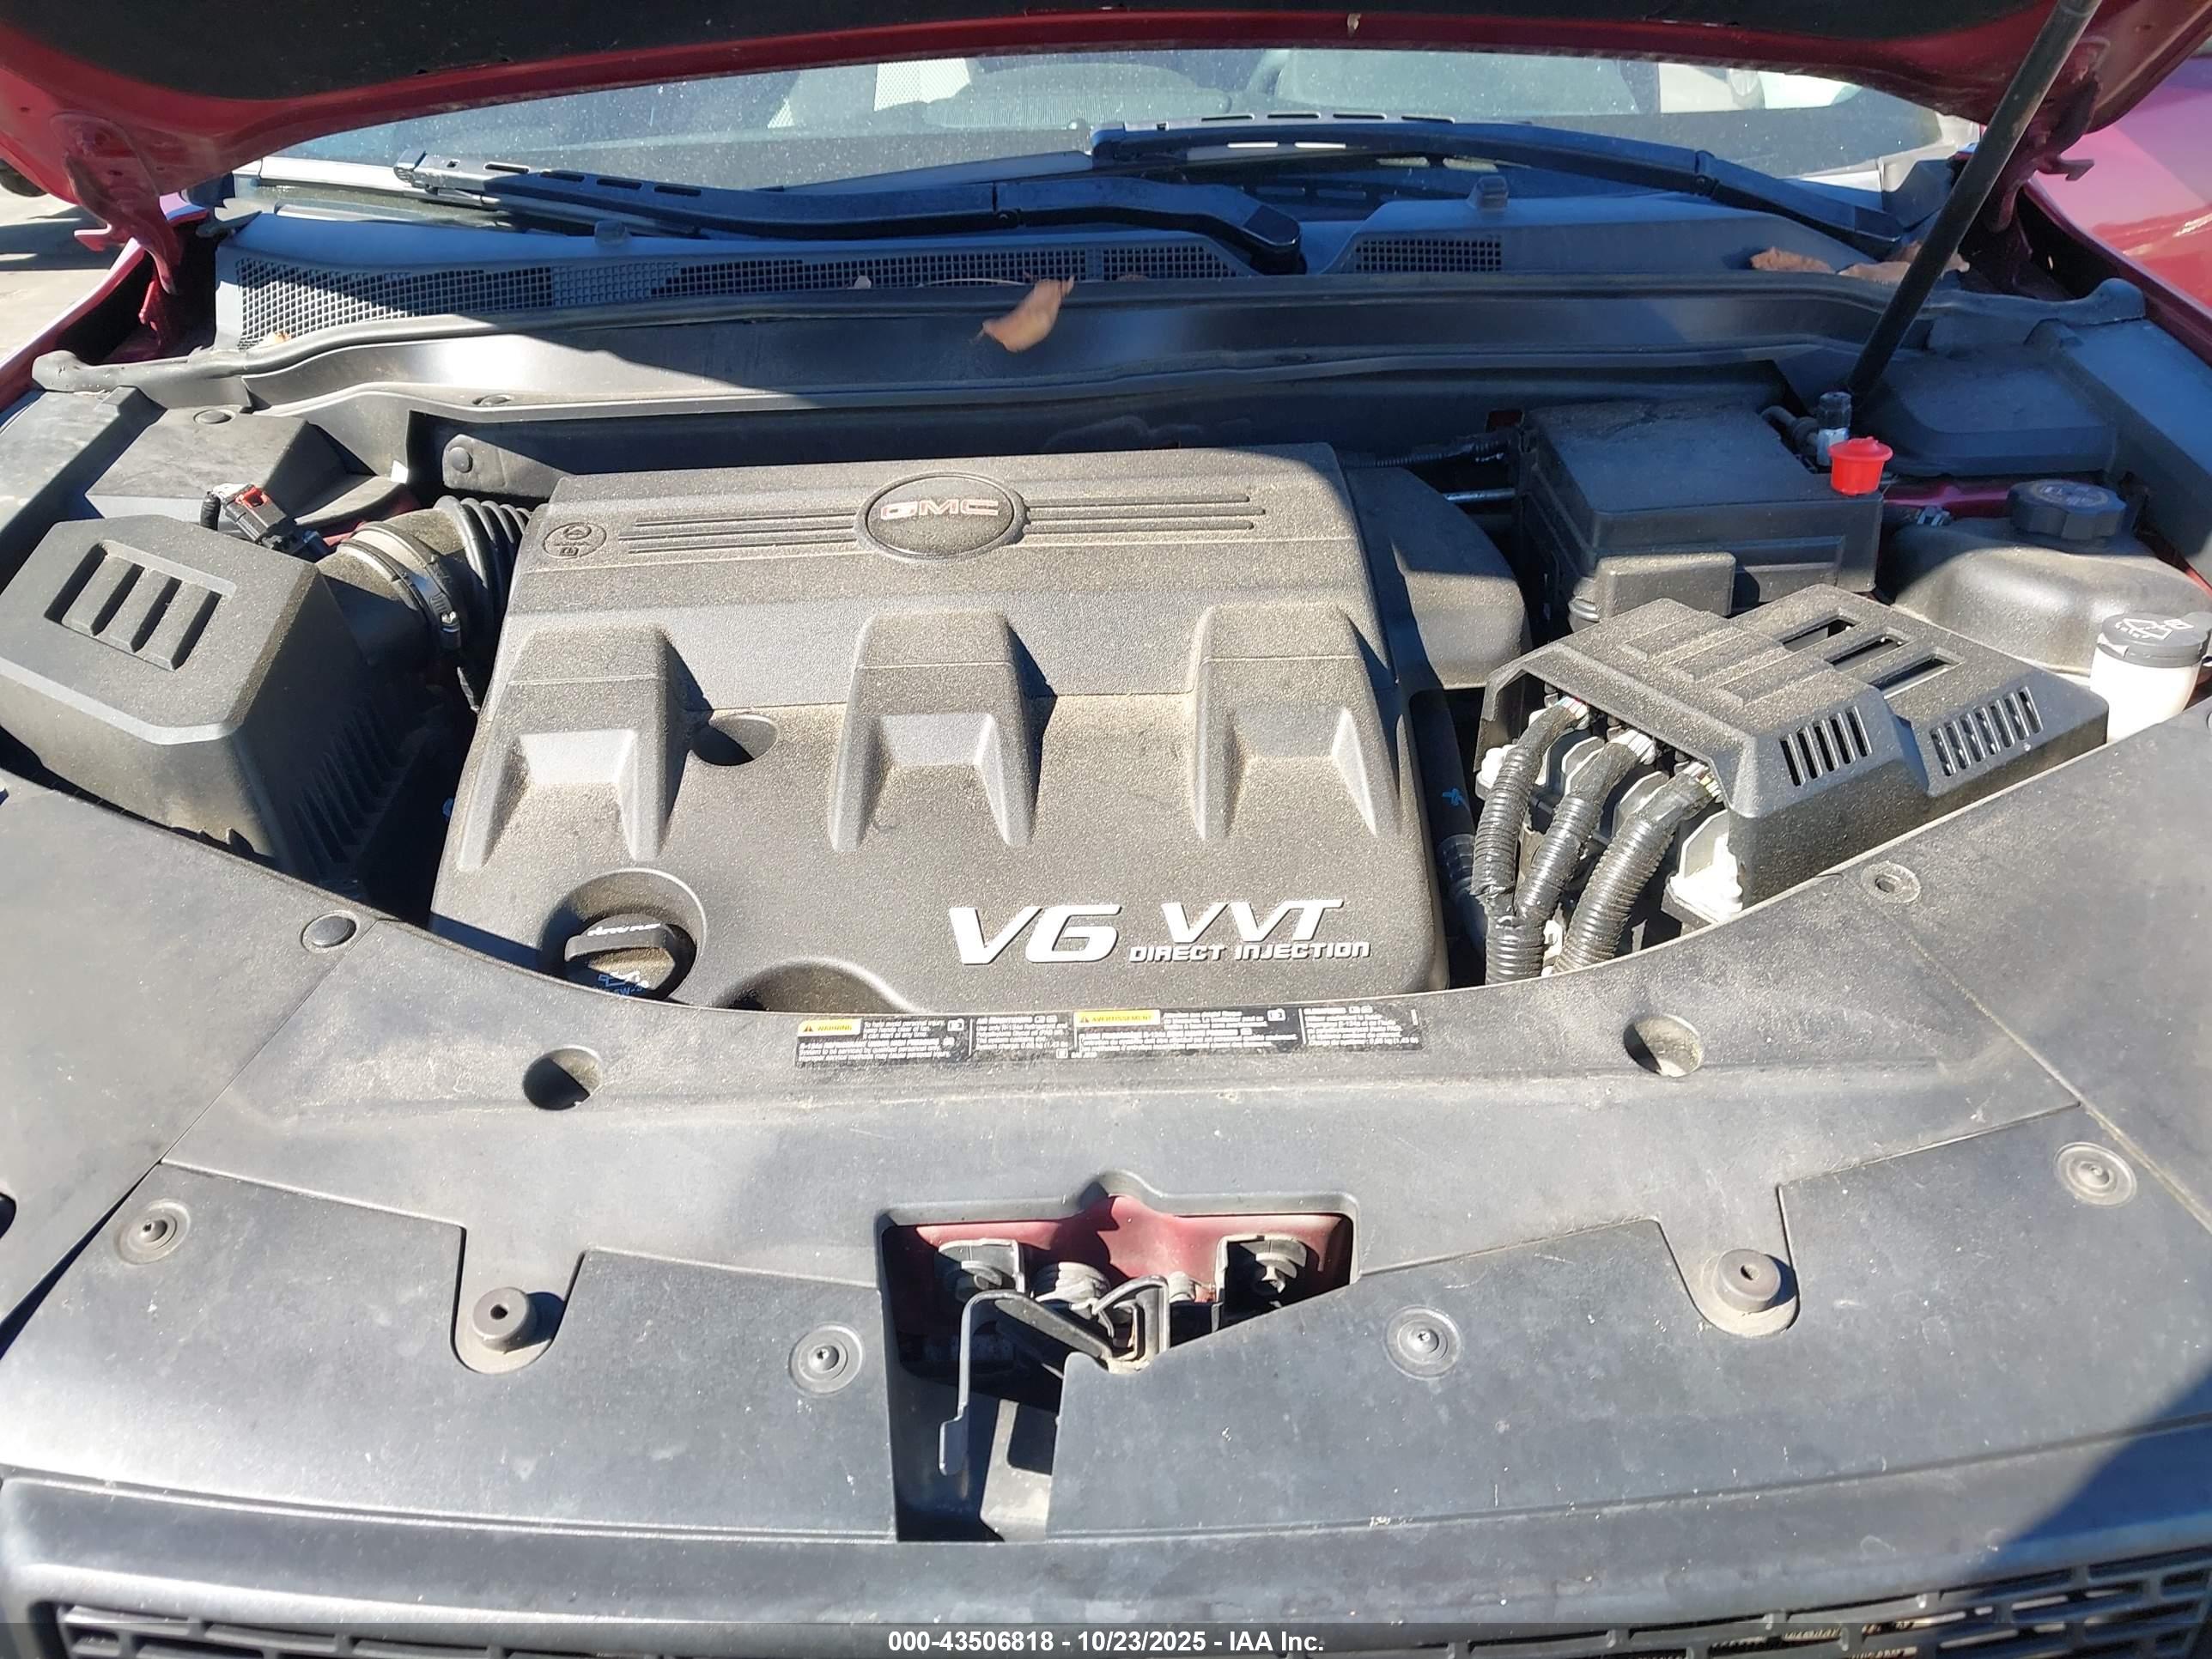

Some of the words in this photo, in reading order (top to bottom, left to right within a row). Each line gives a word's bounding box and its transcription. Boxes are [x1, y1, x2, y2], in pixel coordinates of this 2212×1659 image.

[880, 498, 999, 520] GMC
[949, 905, 1120, 964] V6
[1161, 900, 1343, 943] VVT
[1128, 945, 1225, 963] DIRECT
[1235, 943, 1371, 960] INJECTION
